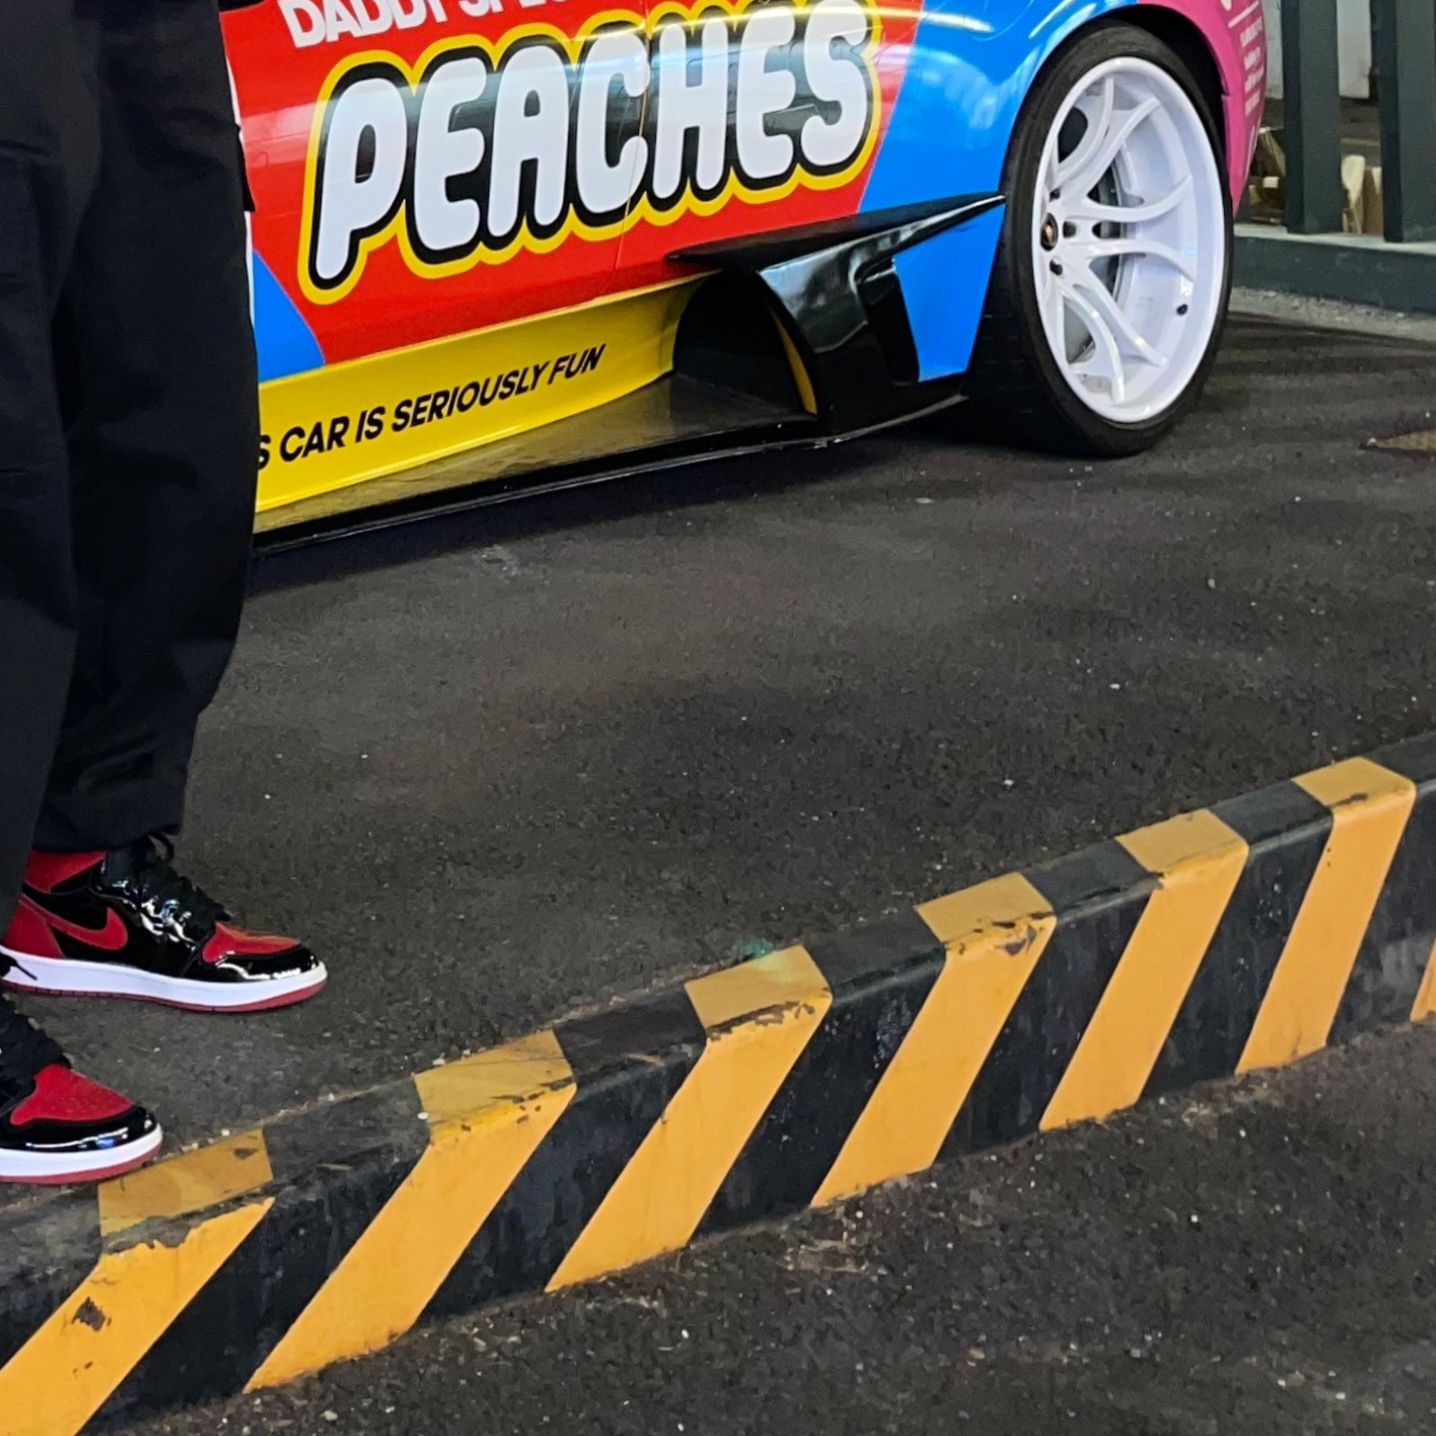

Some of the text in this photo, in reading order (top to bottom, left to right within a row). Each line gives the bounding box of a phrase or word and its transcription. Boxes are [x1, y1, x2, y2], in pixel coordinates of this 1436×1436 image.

[279, 415, 350, 463] CAR
[355, 406, 386, 444] IS
[391, 360, 551, 433] SERIOUSLY
[547, 343, 607, 385] FUN
